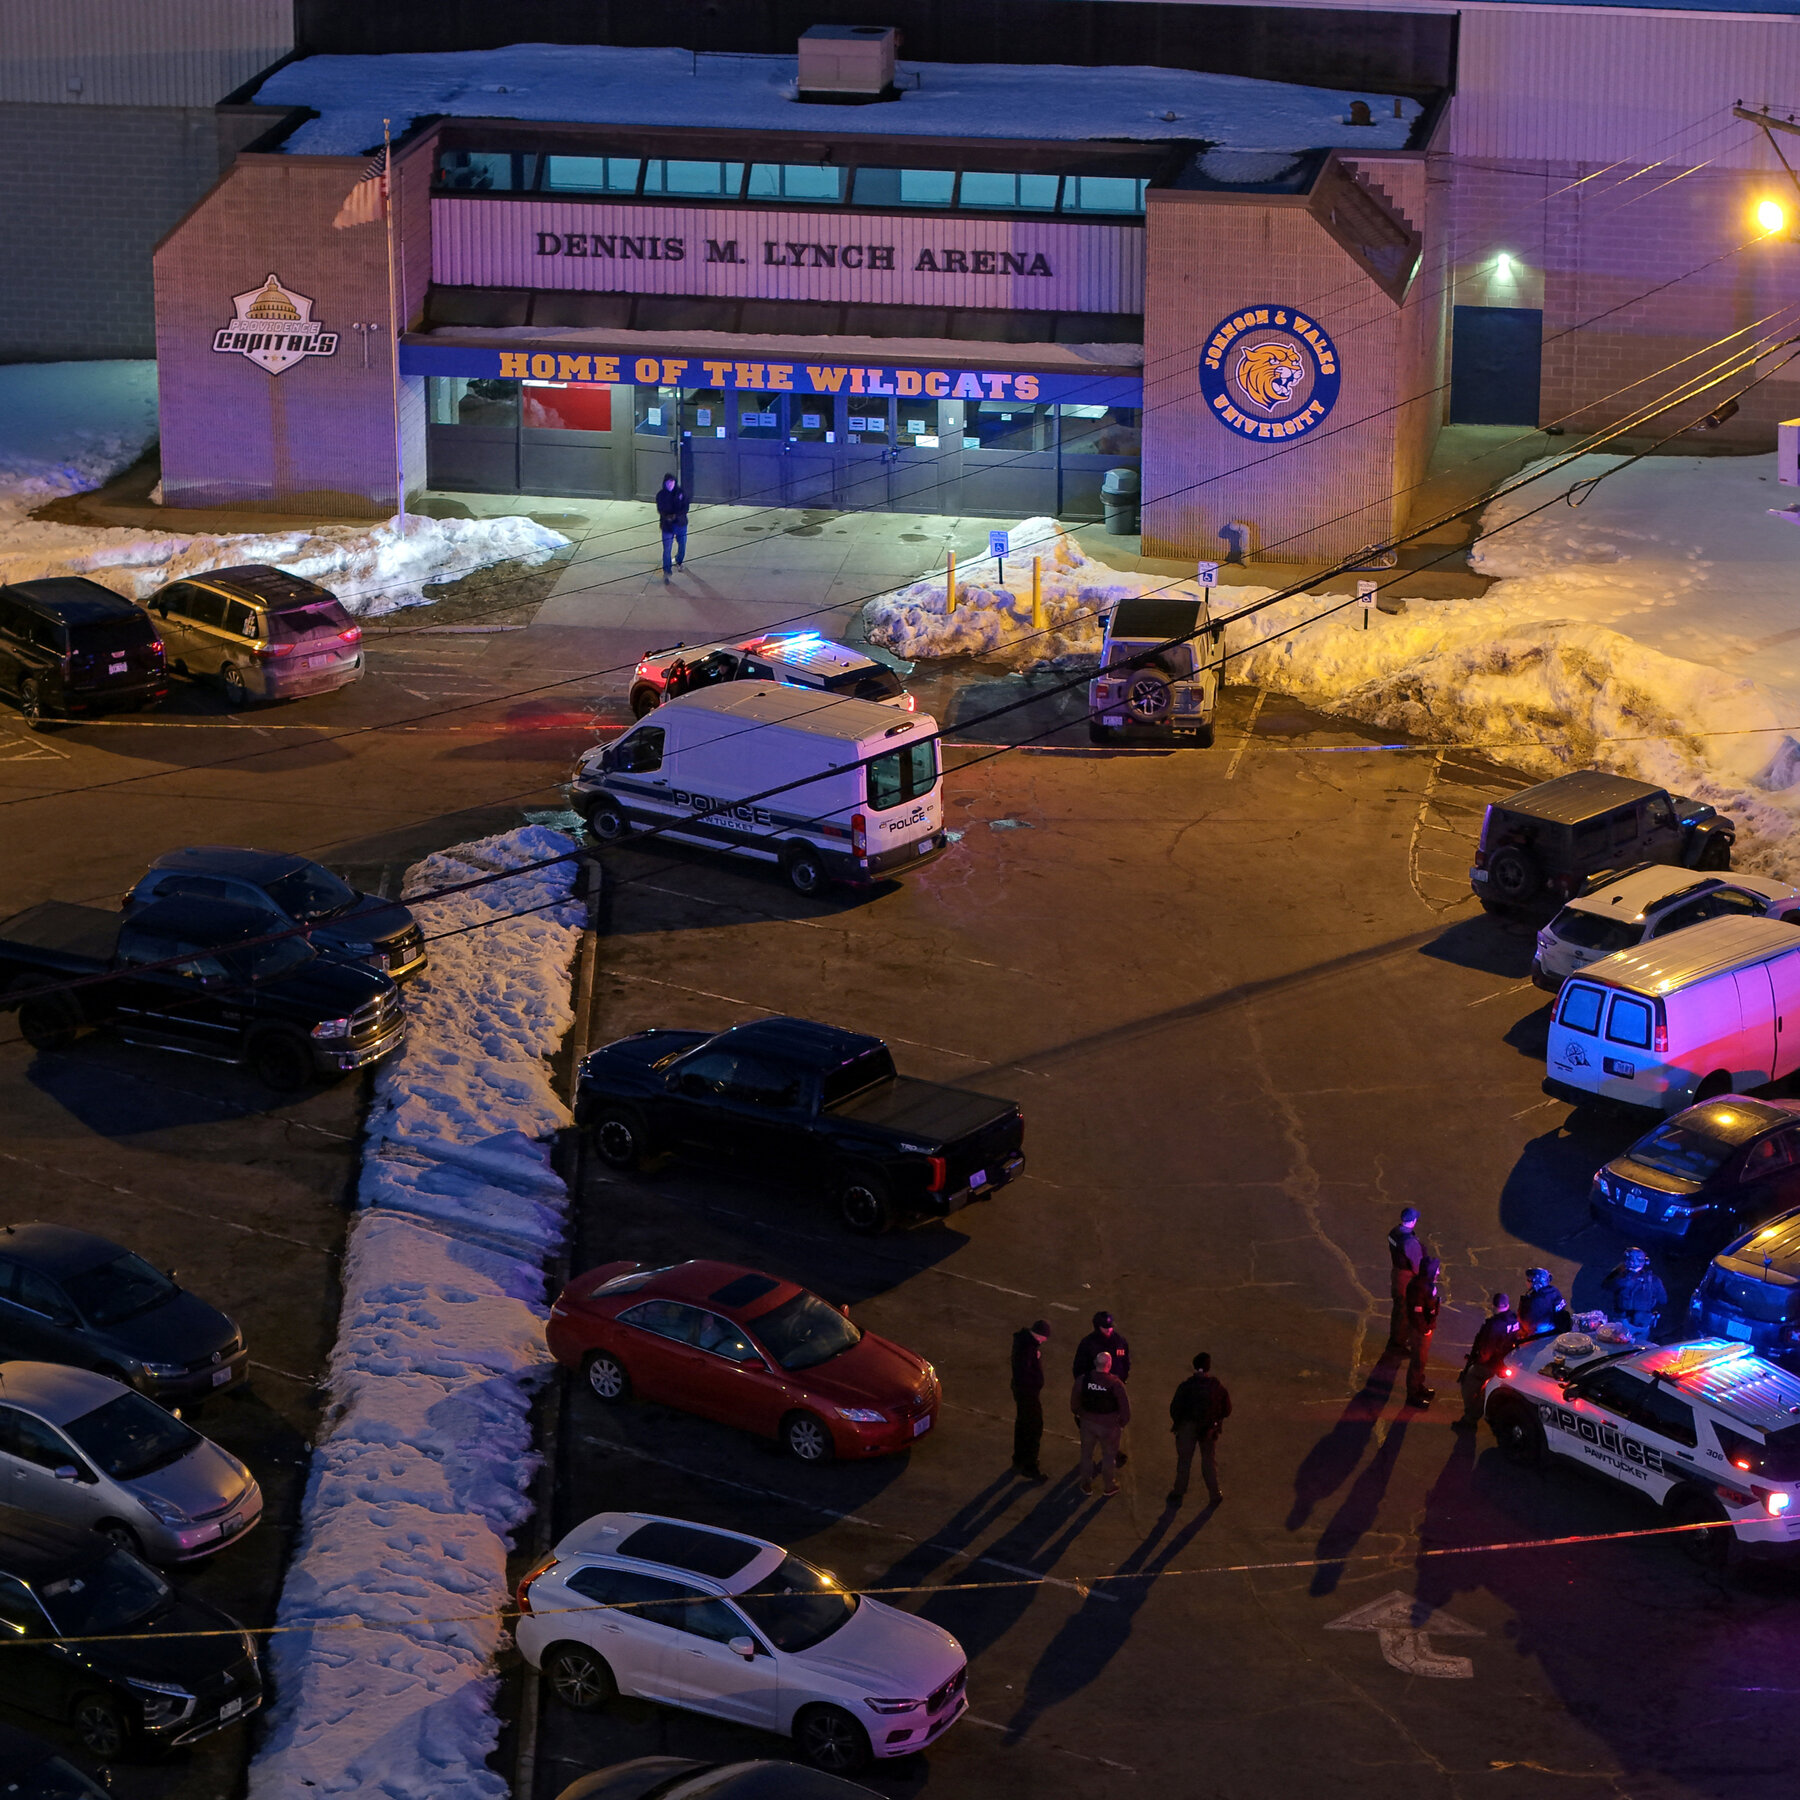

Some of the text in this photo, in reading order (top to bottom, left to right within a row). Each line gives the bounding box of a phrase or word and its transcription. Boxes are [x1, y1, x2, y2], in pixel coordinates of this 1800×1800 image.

[536, 232, 1054, 278] DENNIS M. LYNCH ARENA
[216, 332, 335, 354] CAPITALS
[229, 320, 319, 333] PROVIDENCE
[1205, 309, 1336, 375] JOHNSON & WALES
[499, 352, 1040, 400] HOME OF THE WILDCATS
[1213, 393, 1325, 438] UNIVERSITY
[695, 812, 755, 832] WTUCKET
[889, 811, 926, 833] POLICE
[1557, 1406, 1666, 1477] POLICE
[1584, 1446, 1648, 1480] PAWTUCKET
